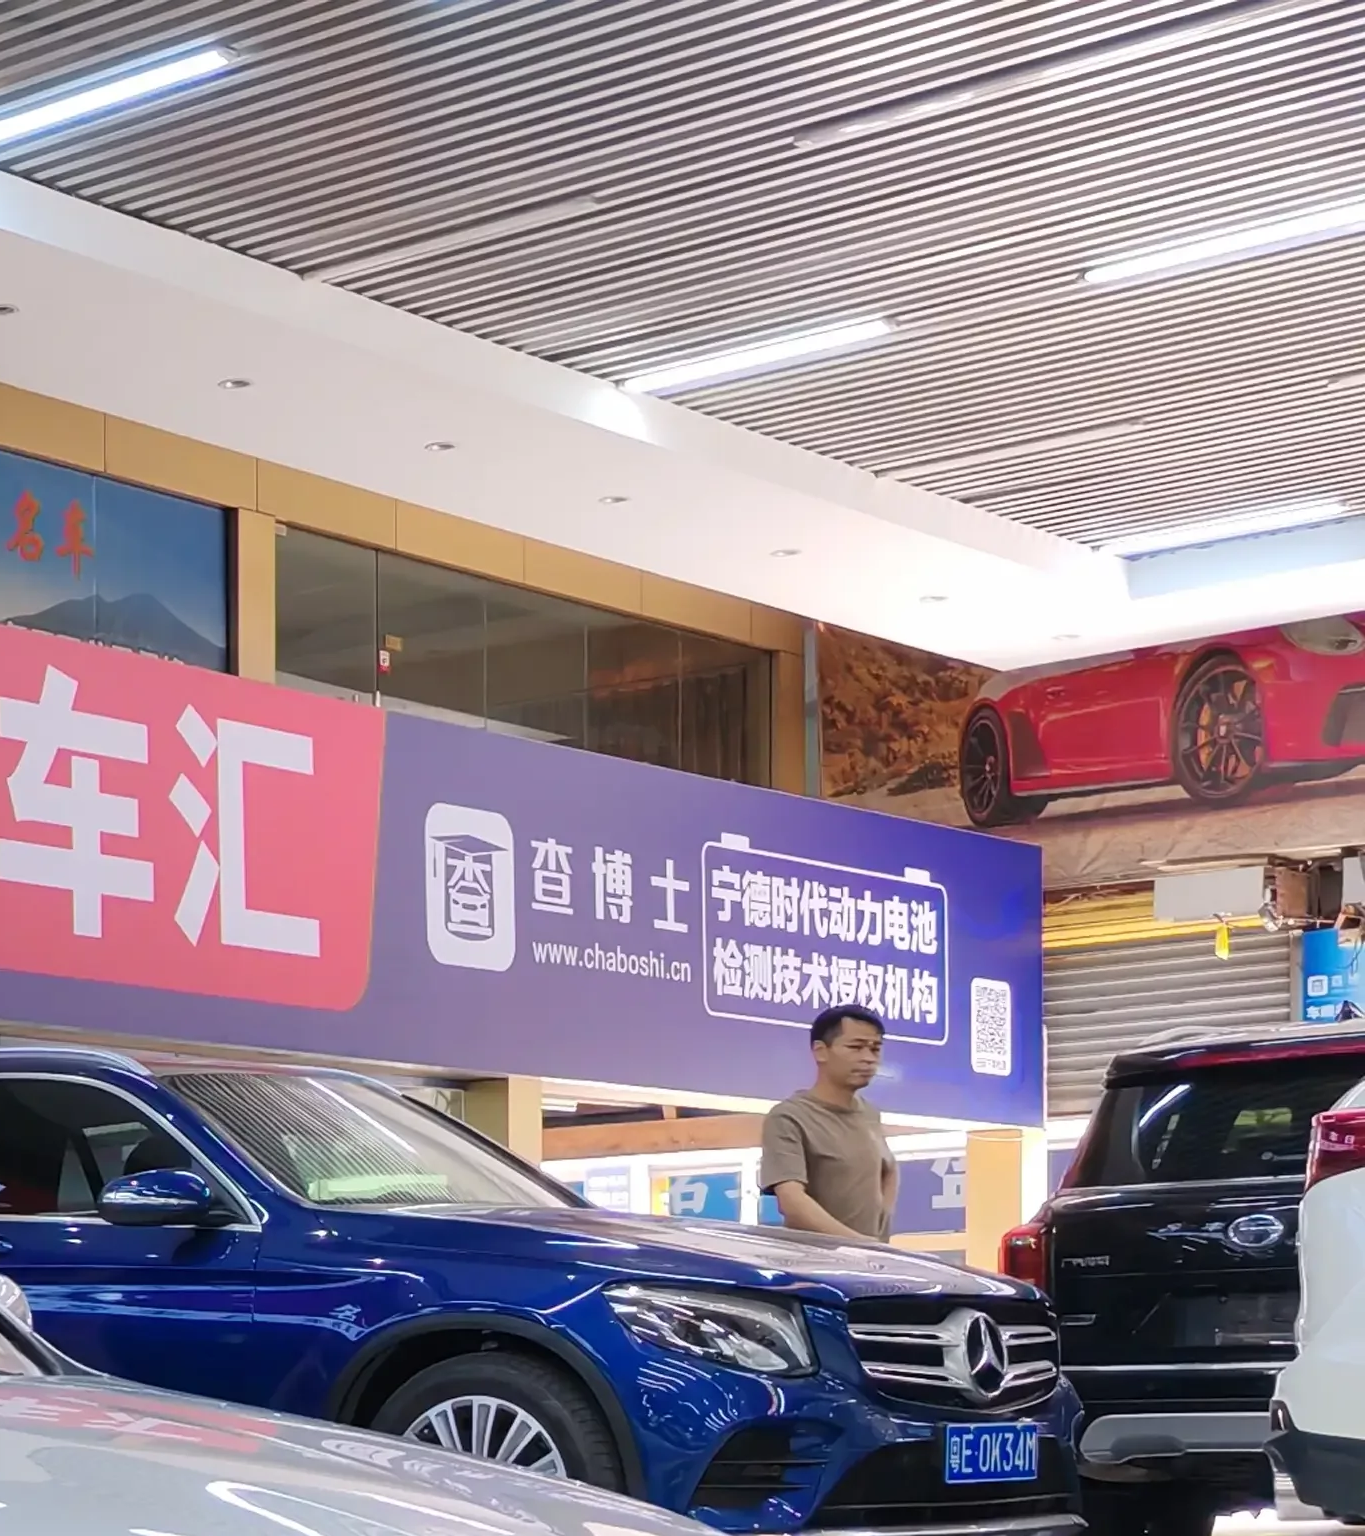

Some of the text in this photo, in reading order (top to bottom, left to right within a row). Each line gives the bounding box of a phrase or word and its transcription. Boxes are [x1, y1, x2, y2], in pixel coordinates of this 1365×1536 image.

[530, 837, 690, 933] 查博士
[711, 865, 938, 955] 宁德时代动力电池
[532, 941, 692, 983] www.chaboshi.cn
[713, 937, 939, 1026] 检测技术授权机构
